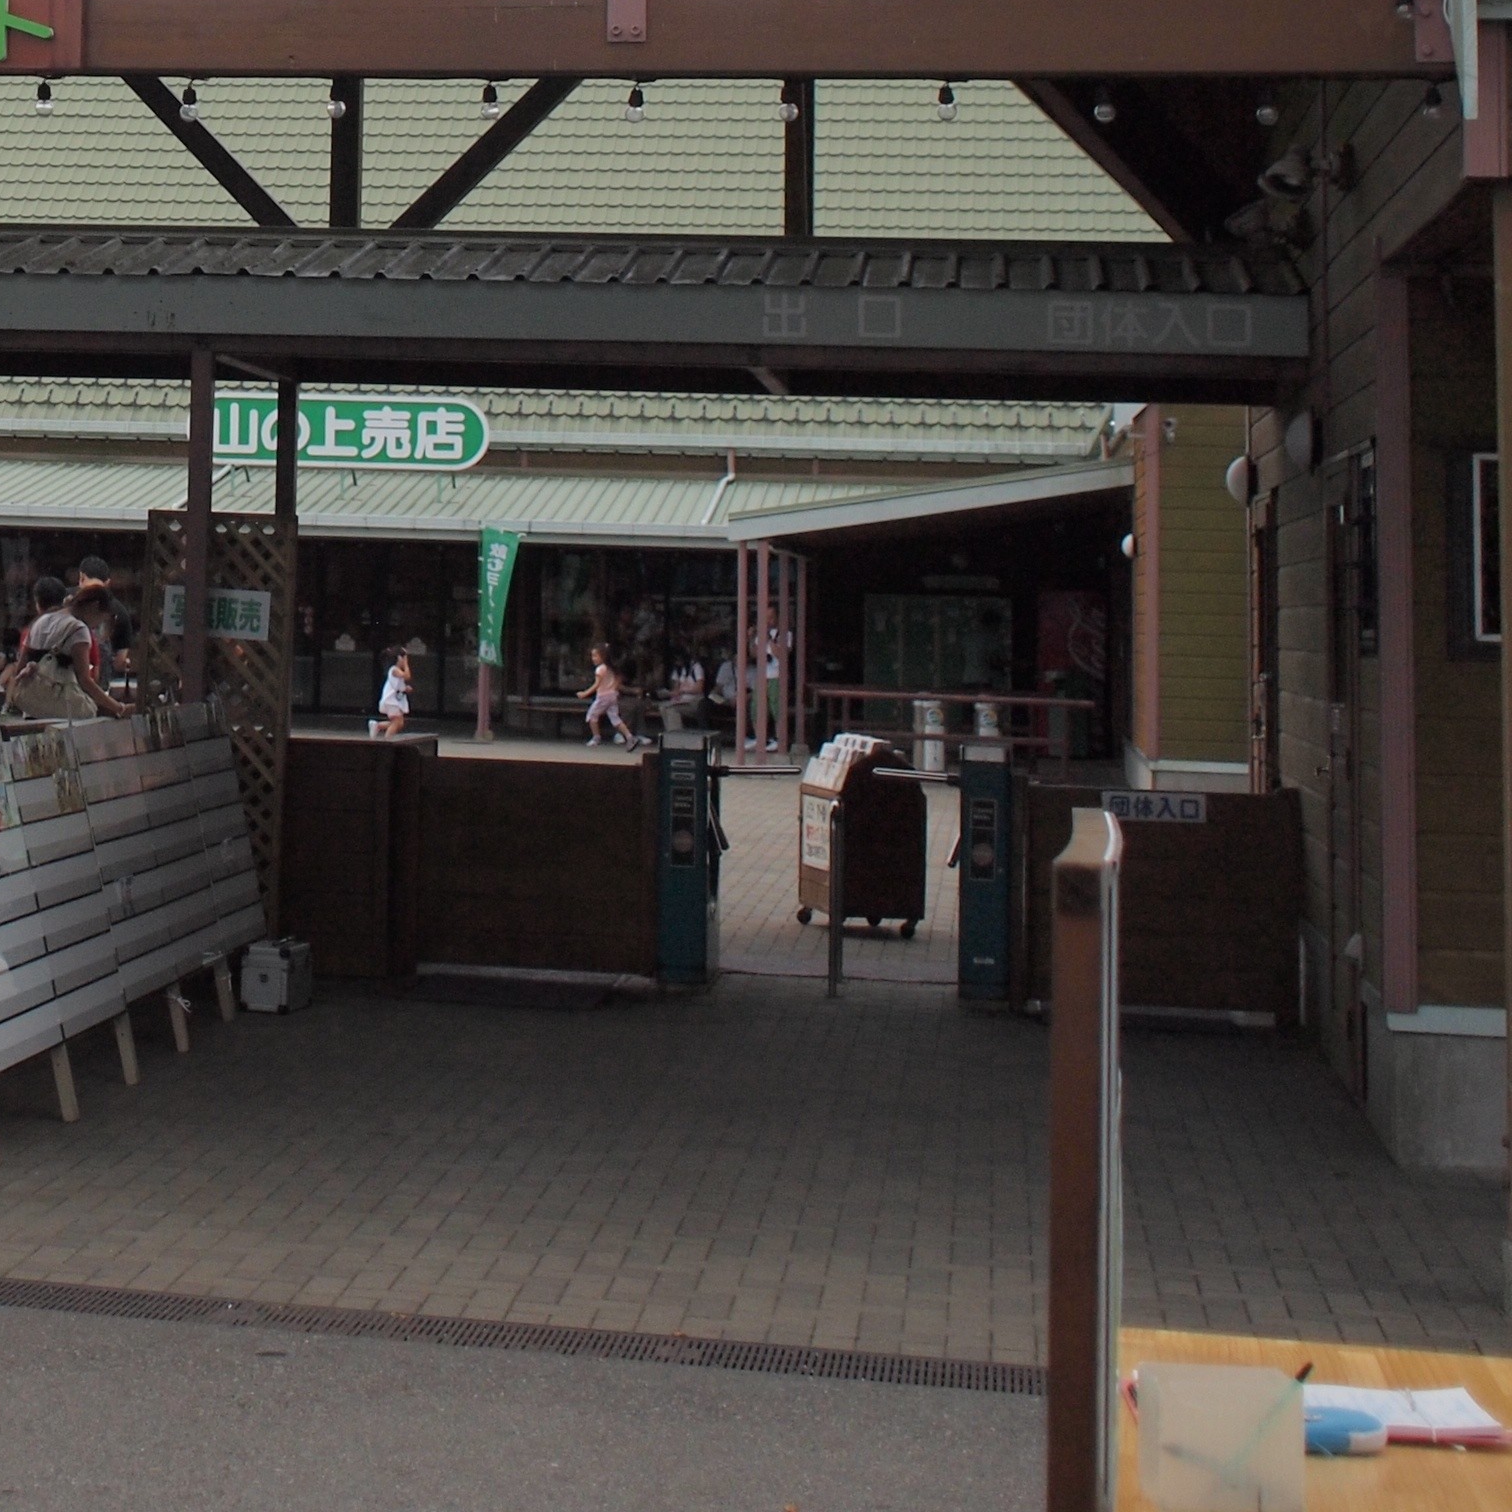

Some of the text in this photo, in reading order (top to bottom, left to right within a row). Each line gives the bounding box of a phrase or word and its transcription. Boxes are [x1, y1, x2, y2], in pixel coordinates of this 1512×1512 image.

[762, 290, 901, 339] 出口
[1046, 299, 1254, 348] 団体入口
[213, 401, 466, 461] 山の上売店
[1109, 795, 1200, 820] 団体入口
